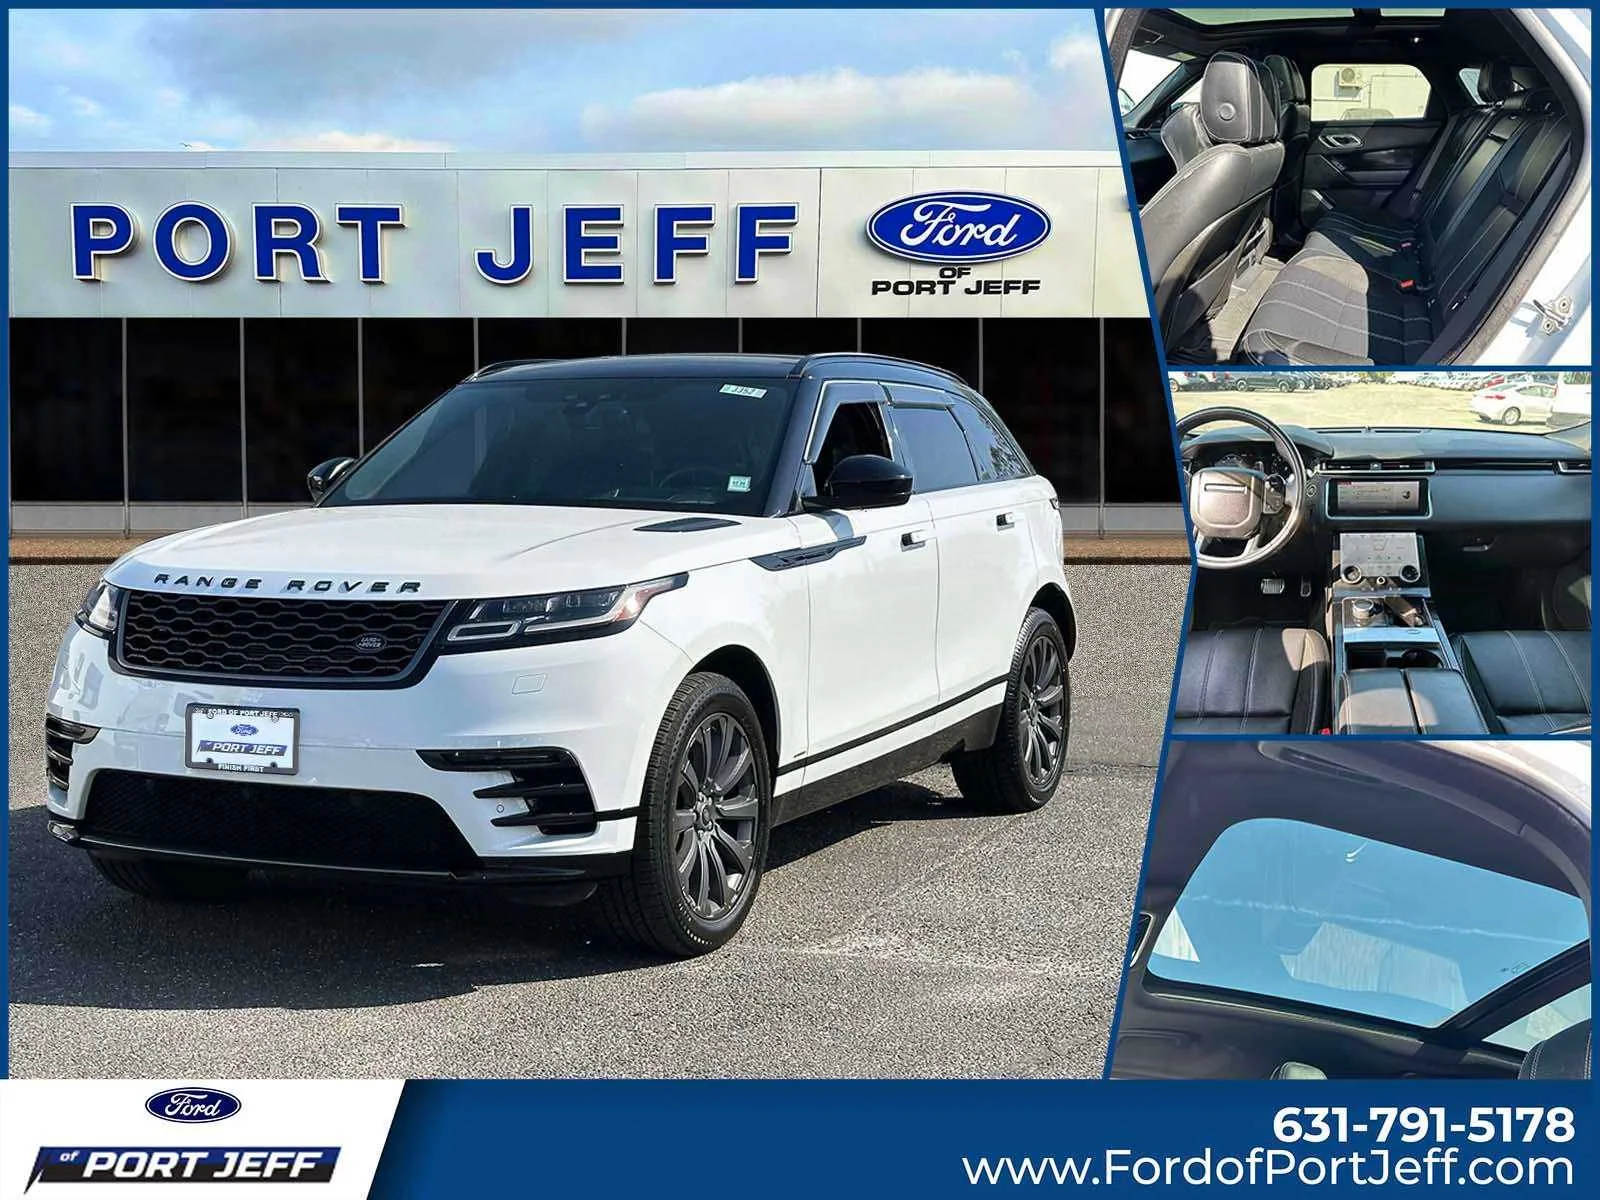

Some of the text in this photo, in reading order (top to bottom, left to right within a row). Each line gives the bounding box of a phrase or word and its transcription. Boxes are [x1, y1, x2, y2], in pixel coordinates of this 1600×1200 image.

[900, 201, 1021, 246] Ford
[70, 202, 799, 284] PORT JEFF
[939, 266, 972, 279] OF
[871, 279, 1041, 296] PORT JEFF
[154, 573, 422, 594] RANGE ROVER
[212, 742, 249, 752] PORT
[250, 744, 282, 754] JEFF
